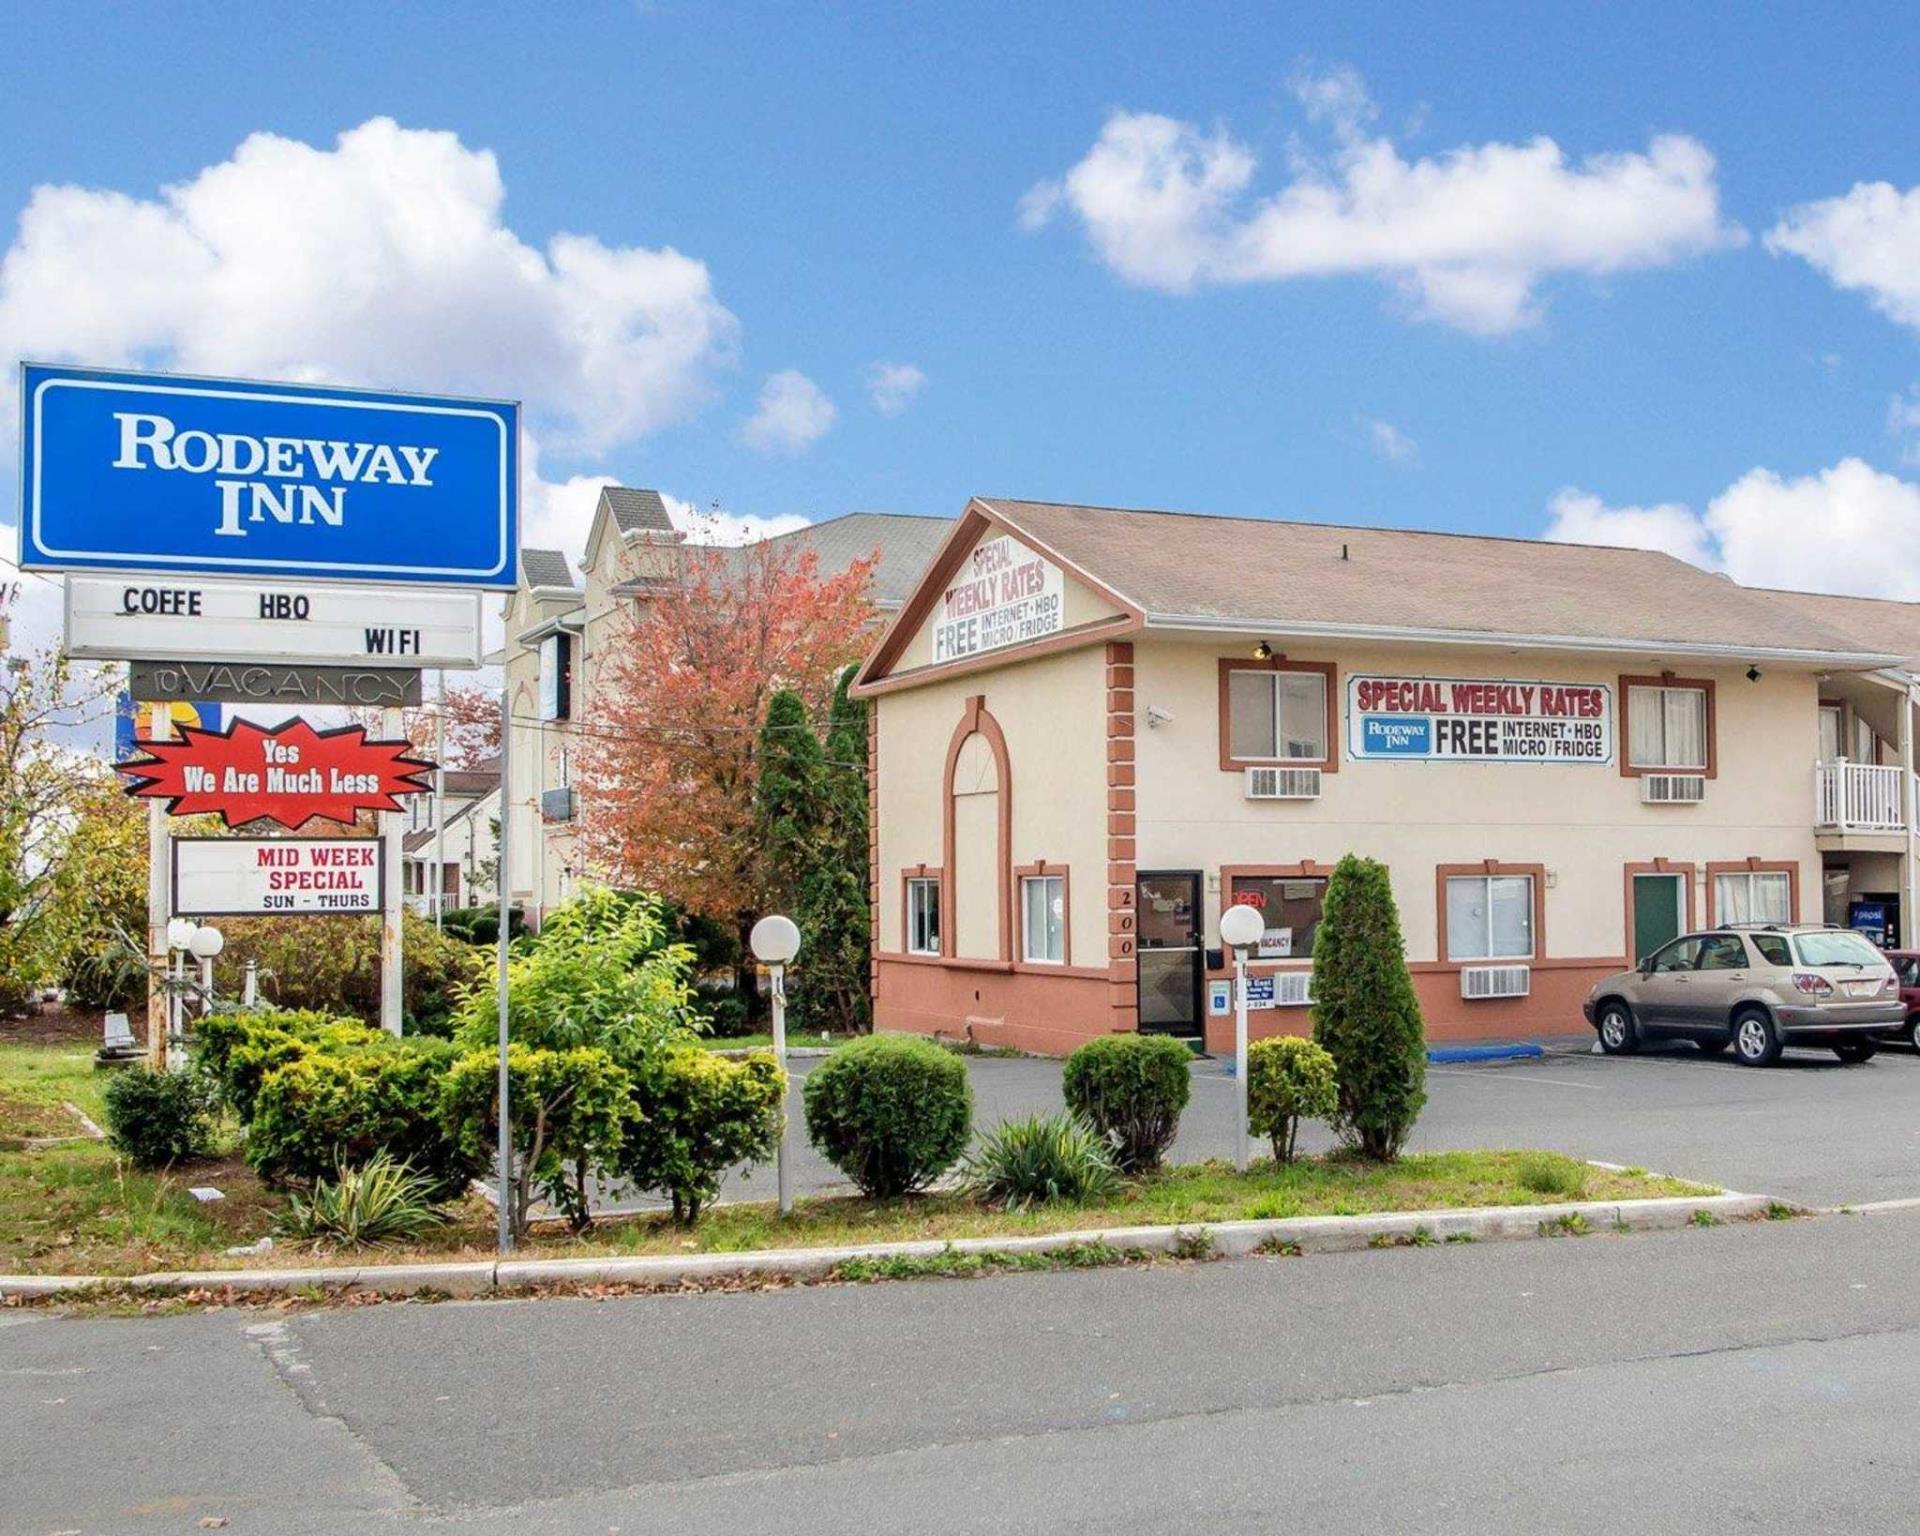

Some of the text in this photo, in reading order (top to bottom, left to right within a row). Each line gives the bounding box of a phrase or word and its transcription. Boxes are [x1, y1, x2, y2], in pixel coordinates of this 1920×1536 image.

[113, 412, 440, 486] RODEWAY
[215, 480, 347, 536] INN
[973, 539, 1012, 577] SPECIAL
[123, 589, 311, 620] COFFE HBO
[945, 559, 1045, 620] WEEKLY RATES
[982, 593, 1059, 631] INTERNET HBO
[365, 628, 421, 655] WIFI
[937, 618, 977, 660] FREE
[181, 664, 417, 702] VACANCY
[1358, 681, 1603, 718] SPECIAL WEEKLY RATES
[1368, 721, 1426, 736] RODEWAY
[1385, 735, 1409, 748] INN
[1435, 719, 1499, 755] FREE
[1503, 722, 1602, 739] INTERNET HBO
[262, 740, 300, 764] Yes
[183, 766, 379, 794] We Are Much Less
[257, 848, 375, 867] MID WEEK
[269, 871, 363, 890] SPECIAL
[263, 895, 295, 908] SUN
[318, 895, 370, 908] THURS
